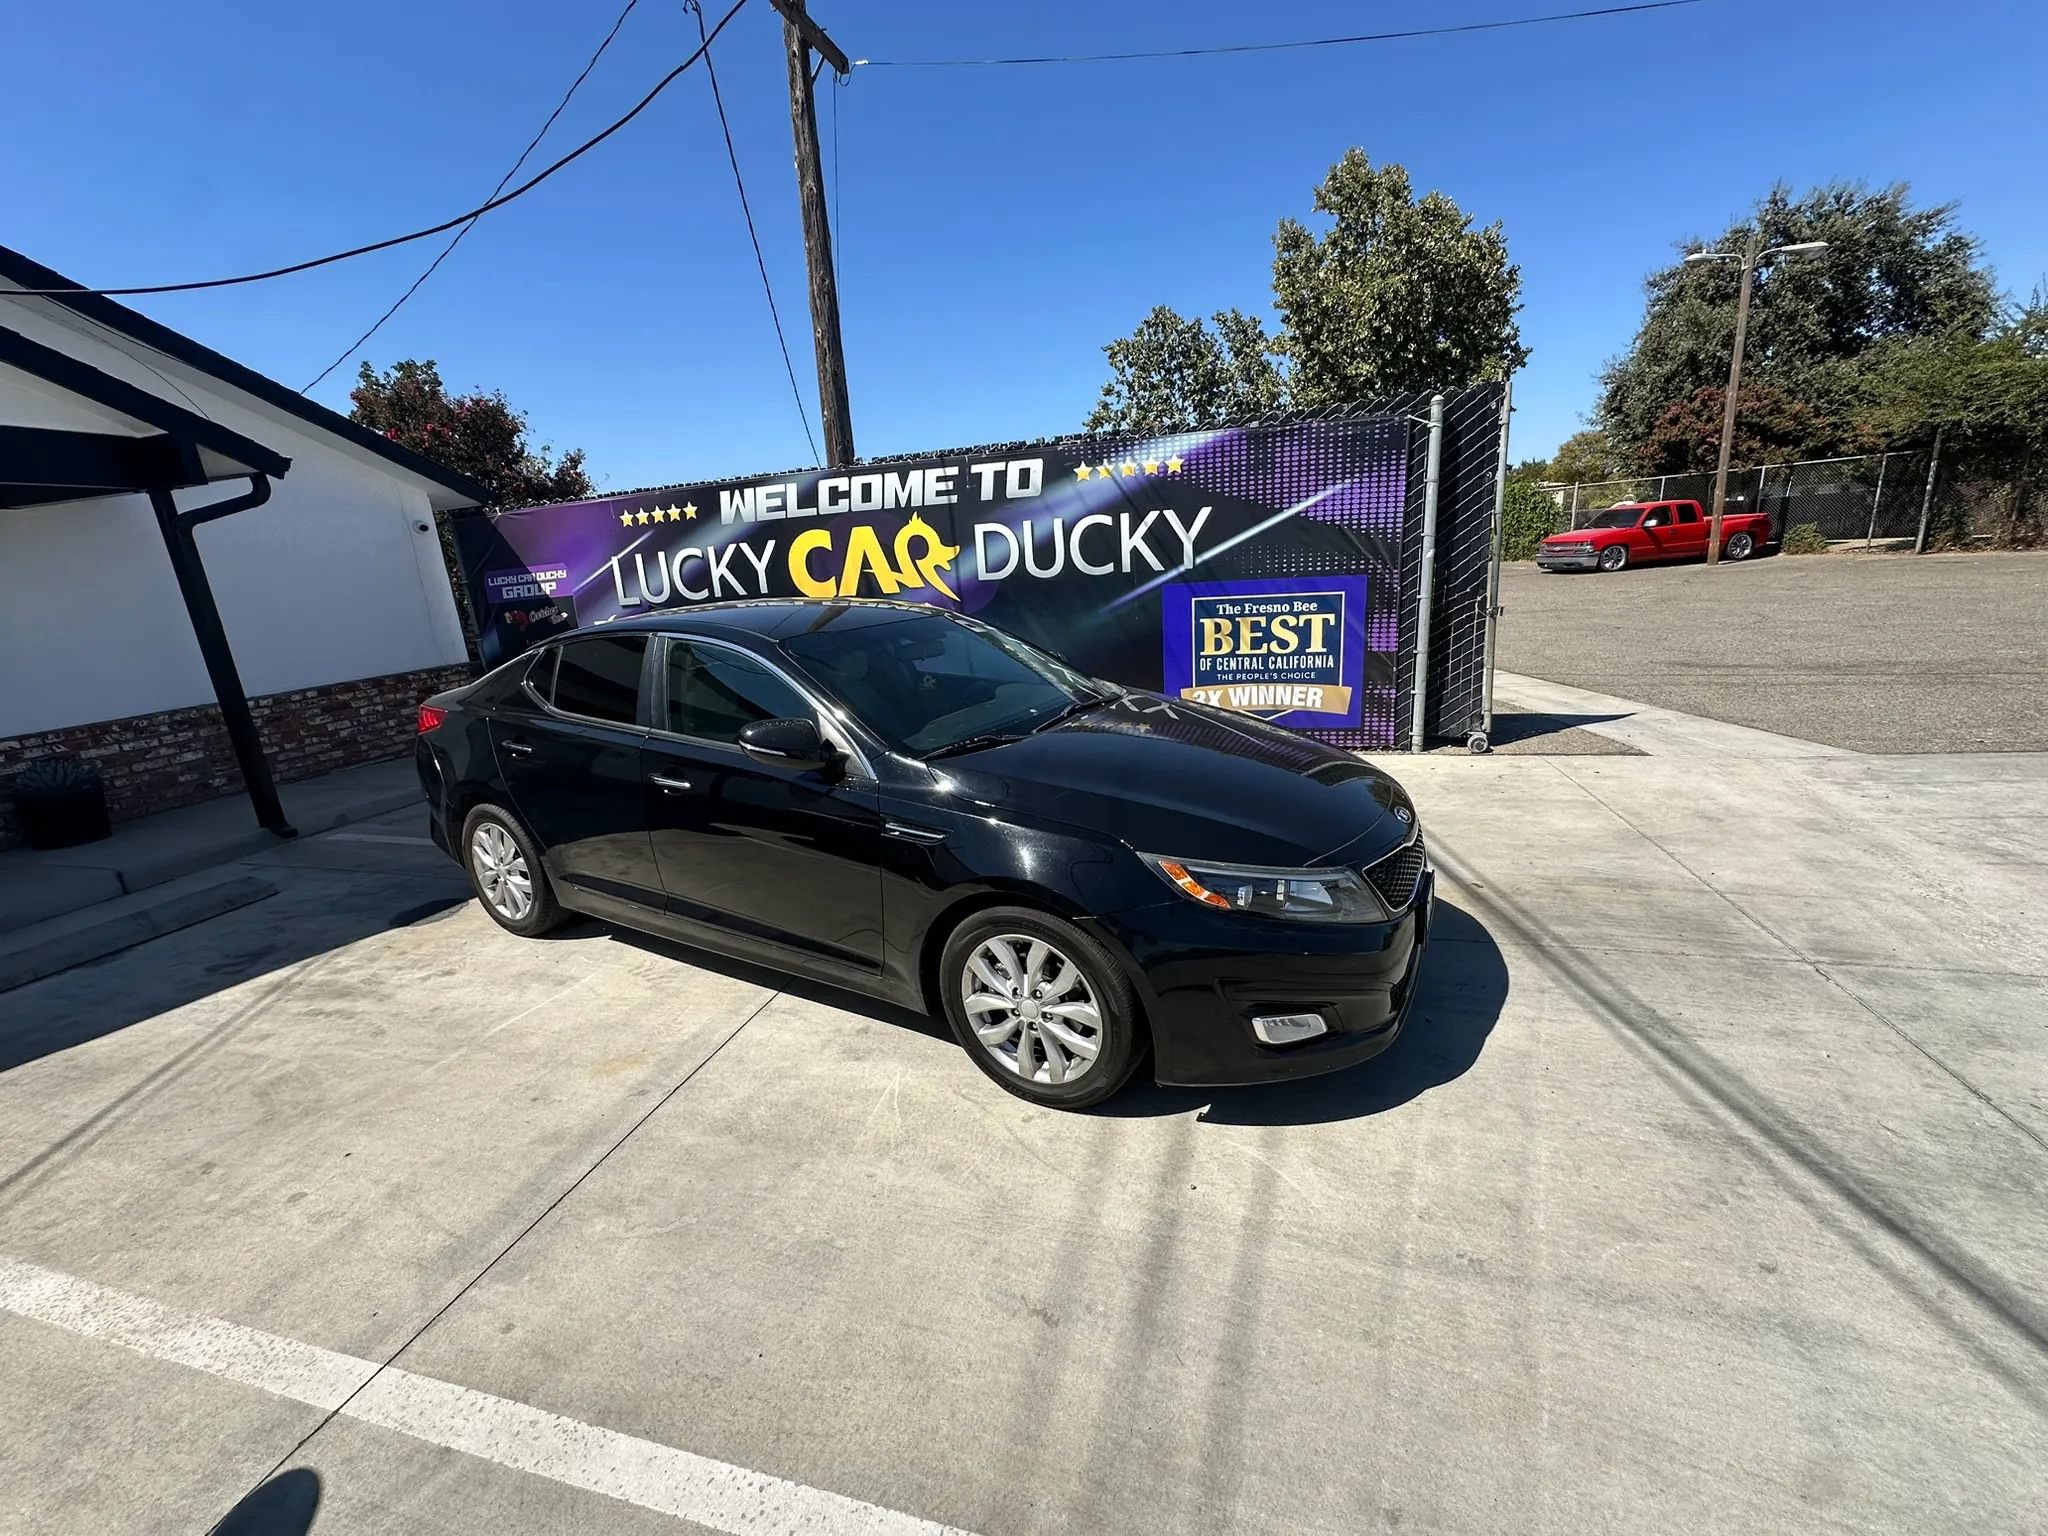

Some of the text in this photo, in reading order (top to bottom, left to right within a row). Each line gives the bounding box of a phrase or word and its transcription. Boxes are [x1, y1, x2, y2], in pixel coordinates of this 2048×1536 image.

[719, 458, 1044, 525] WELCOME TO
[610, 506, 1213, 607] LUCKY CAR DUCKY
[488, 569, 567, 586] LUCKY CAR DUCKY
[502, 581, 557, 599] GROUP
[1216, 601, 1318, 615] The Fresno Bee
[1200, 613, 1336, 656] BEST
[1200, 655, 1334, 671] OF CENTRAL CALIFORNIA
[1217, 671, 1316, 681] THE PEOPLE'S CHOICE
[1227, 685, 1324, 708] WINNER
